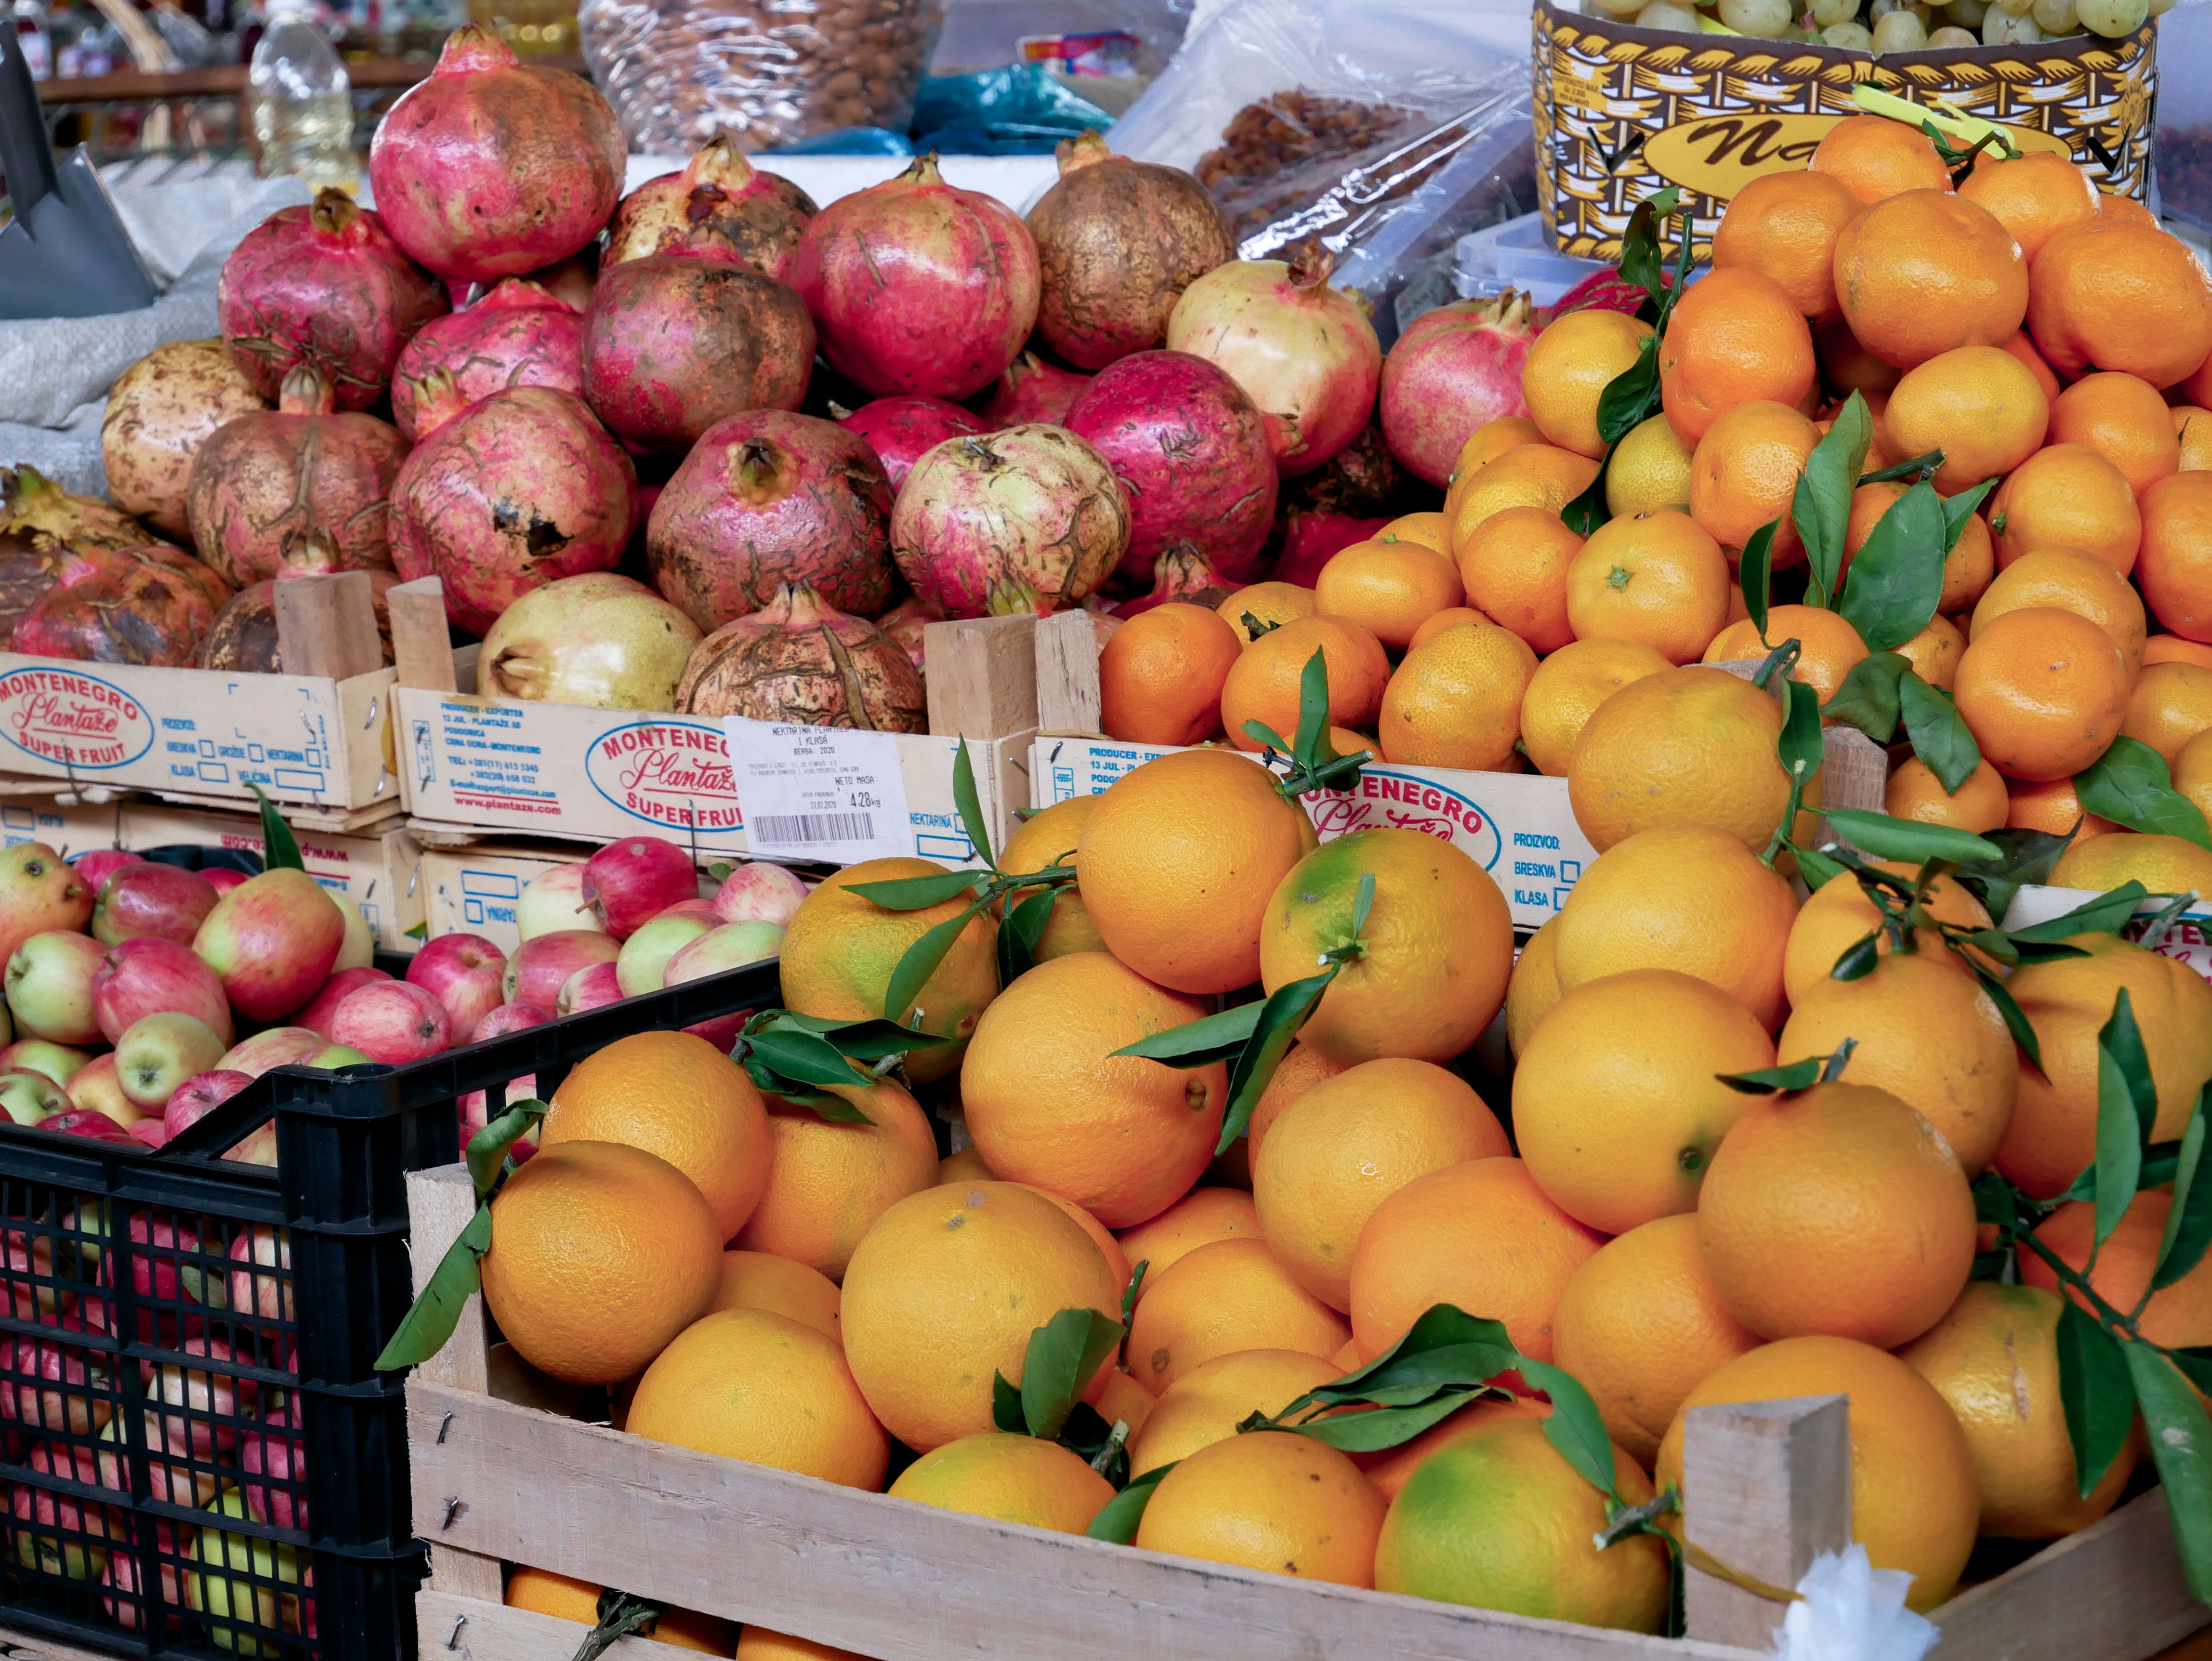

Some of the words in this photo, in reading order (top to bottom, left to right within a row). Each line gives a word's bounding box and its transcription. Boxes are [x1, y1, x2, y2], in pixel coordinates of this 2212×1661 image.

[1687, 119, 1821, 166] Na
[0, 672, 138, 721] MONTENEGRO
[11, 690, 119, 733] Plantaže
[20, 731, 75, 762] SUPER
[79, 742, 125, 764] FRUIT
[820, 746, 835, 754] 2020
[1089, 747, 1138, 760] PRODUCER
[619, 748, 737, 792] Plantaž
[1090, 760, 1101, 769] 13
[1103, 762, 1120, 771] JUL
[835, 776, 853, 785] NETO
[454, 797, 561, 815] www.plantaze.com
[626, 791, 692, 825] SUPER
[698, 806, 742, 826] FRUI
[1299, 776, 1483, 834] ENEGRO
[909, 812, 953, 829] NEKTARINA
[1514, 861, 1556, 879] BRESKVA
[1514, 889, 1549, 907] KLASA
